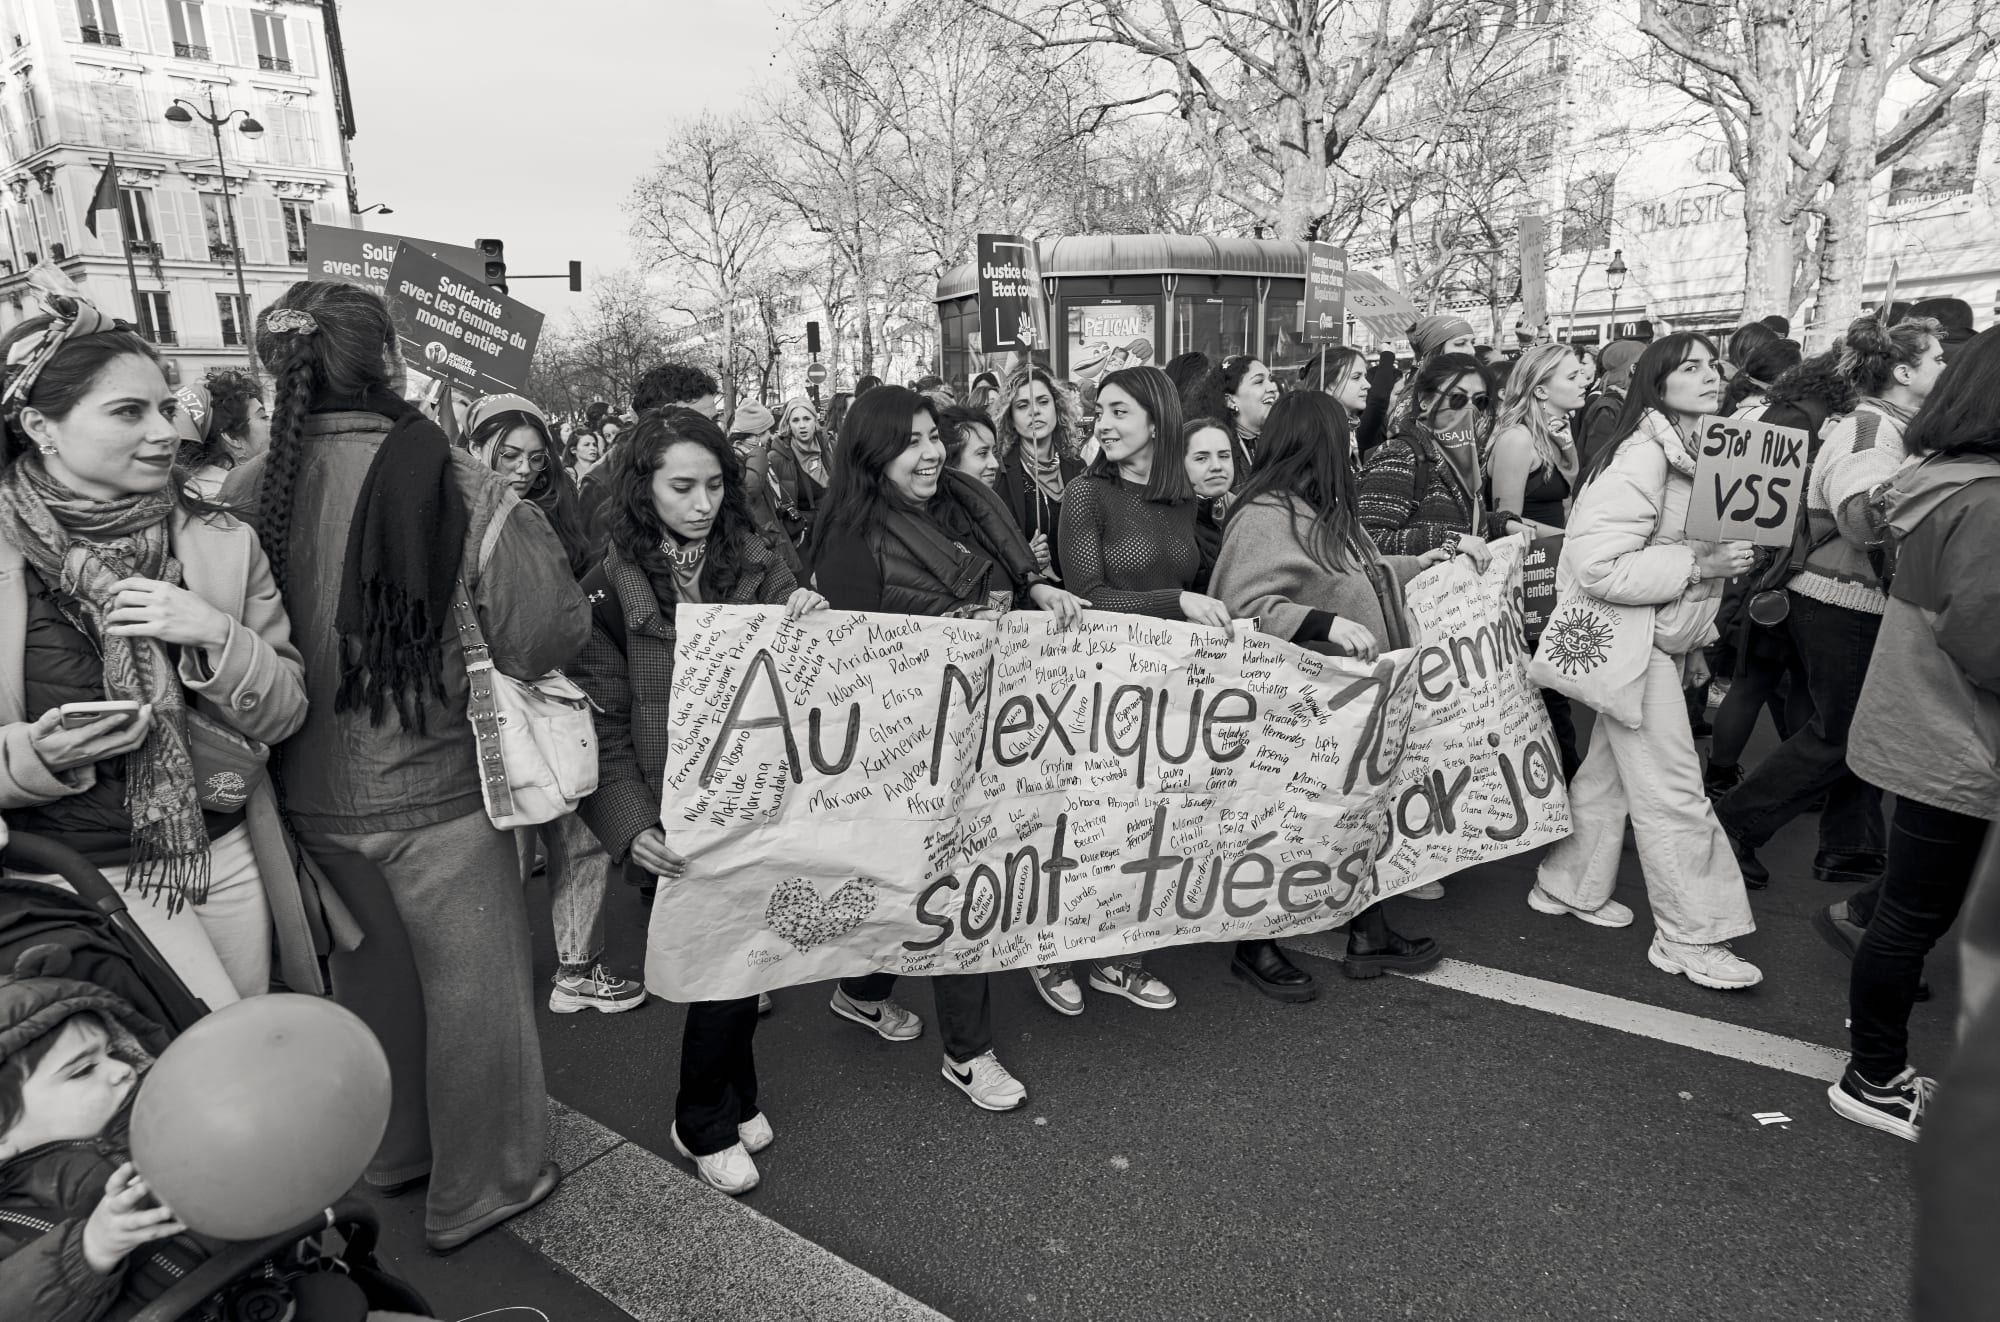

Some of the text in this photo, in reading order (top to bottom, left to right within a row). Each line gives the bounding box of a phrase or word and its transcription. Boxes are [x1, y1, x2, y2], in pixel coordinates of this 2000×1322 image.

[1642, 190, 1735, 232] MAJESTIC
[323, 260, 389, 280] avec les
[982, 262, 1020, 279] Justice
[438, 276, 502, 319] Solidarité
[992, 280, 1016, 297] Etat
[400, 280, 433, 305] avec
[435, 294, 457, 316] les
[457, 305, 510, 343] femmes
[510, 331, 527, 350] du
[416, 307, 503, 357] monde entier
[1703, 423, 1803, 469] STOP AUX
[1715, 472, 1791, 529] VSS
[1527, 582, 1553, 598] entier
[1561, 595, 1622, 626] MONTEVIDEO
[826, 613, 867, 647] Rosita
[868, 619, 922, 644] Marcela
[1007, 617, 1029, 635] Paola
[1128, 622, 1173, 646] Michelle
[779, 628, 807, 674] Violeta
[1073, 637, 1081, 653] de
[1243, 635, 1270, 649] Karen
[785, 637, 820, 693] Carolina
[828, 641, 904, 675] Viridiana
[889, 648, 930, 674] Paloma
[998, 658, 1032, 678] Claudia
[1129, 653, 1167, 674] Yesenia
[794, 654, 825, 706] Esthela
[1035, 664, 1067, 684] Blanca
[827, 673, 874, 706] Wendy
[882, 687, 924, 710] Eloisa
[699, 649, 861, 789] Au
[930, 653, 1257, 788] Mexique
[869, 715, 913, 744] Gloria
[1461, 716, 1485, 734] Sandy
[860, 724, 932, 778] Katherine
[1009, 723, 1045, 756] Claudia
[668, 736, 711, 790] Fernanda
[714, 767, 731, 785] del
[1158, 766, 1184, 780] Laura
[740, 762, 773, 815] Mariana
[762, 760, 790, 818] Guadalupe
[883, 760, 928, 801] Andrea
[980, 772, 999, 787] Eva
[1161, 775, 1191, 791] Curiel
[710, 773, 747, 826] Matilde
[809, 786, 873, 813] Mariana
[1107, 797, 1140, 812] Abigail
[1220, 808, 1249, 821] Rosa
[1250, 800, 1286, 830] Michelle
[961, 815, 993, 845] Luisa
[902, 813, 1079, 951] sont
[1120, 805, 1370, 922] tuées
[1186, 848, 1214, 904] Alejandrina
[1064, 885, 1097, 912] Lourdes
[1153, 880, 1178, 917] Danna
[1264, 911, 1296, 928] Judith
[992, 935, 1025, 959] Michelle
[1063, 935, 1096, 950] Lorena
